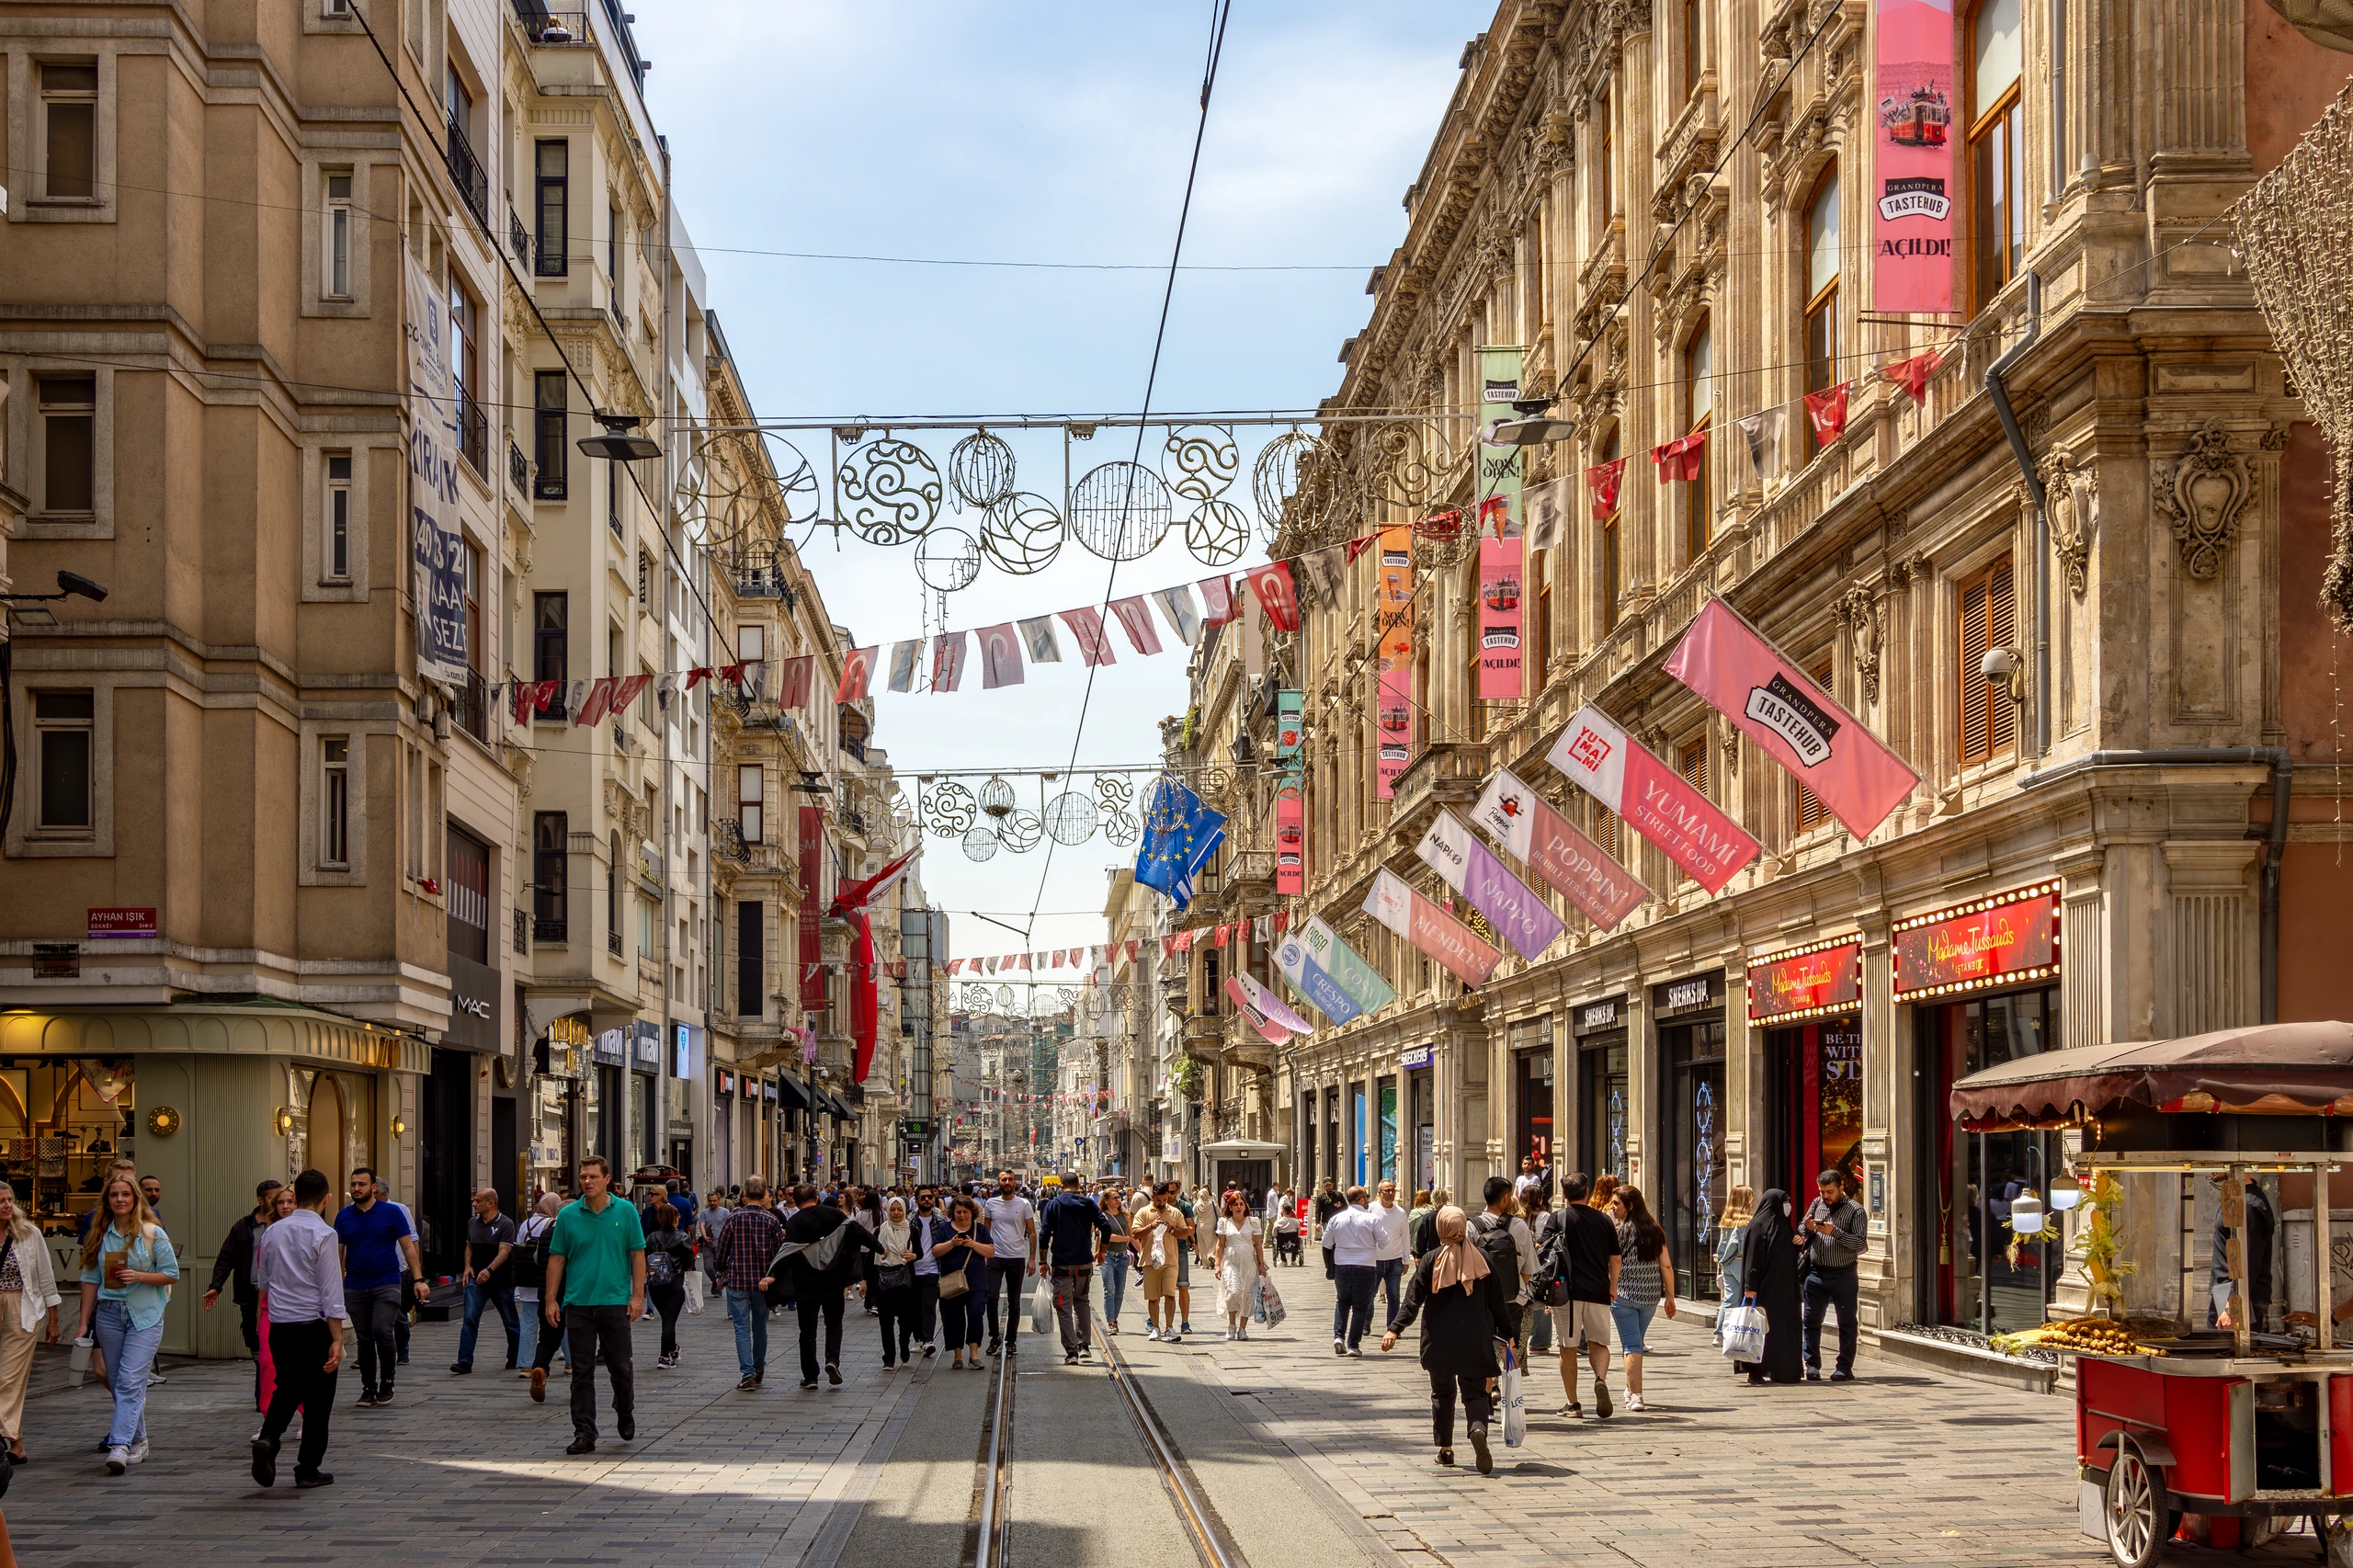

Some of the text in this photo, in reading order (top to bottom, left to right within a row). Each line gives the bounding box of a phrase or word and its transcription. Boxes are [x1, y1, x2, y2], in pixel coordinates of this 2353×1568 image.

[1887, 182, 1943, 192] GRANDPERA
[1887, 196, 1943, 213] TASTEHUB
[1880, 238, 1950, 259] AÇILDI!
[1486, 391, 1517, 399] TASTEHUB
[1483, 466, 1520, 478] OPEN!
[1486, 458, 1517, 468] NOW
[1485, 637, 1517, 645] TASTEHUB
[1483, 658, 1520, 670] AÇILDI!
[1772, 680, 1834, 735] GRANDPERA
[1580, 725, 1598, 743] YU
[1757, 696, 1822, 756] TASTEHUB
[1579, 740, 1599, 760] MA
[1634, 805, 1716, 876] STREET FOOD
[1532, 850, 1618, 925] BUBBLE TEA & COFFEE
[91, 912, 145, 922] AYHAN IŞIK
[1927, 917, 2015, 964] Madame Tussauds
[1344, 967, 1374, 999] ÇOSA
[1771, 960, 1832, 995] Madame Tussauds
[1312, 972, 1351, 1015] CRESPO
[1313, 989, 1336, 1013] BURGER
[601, 1028, 623, 1055] mavi
[1825, 1034, 1844, 1044] BE
[640, 1036, 658, 1063] mavi
[1401, 1047, 1428, 1066] SKECHERS
